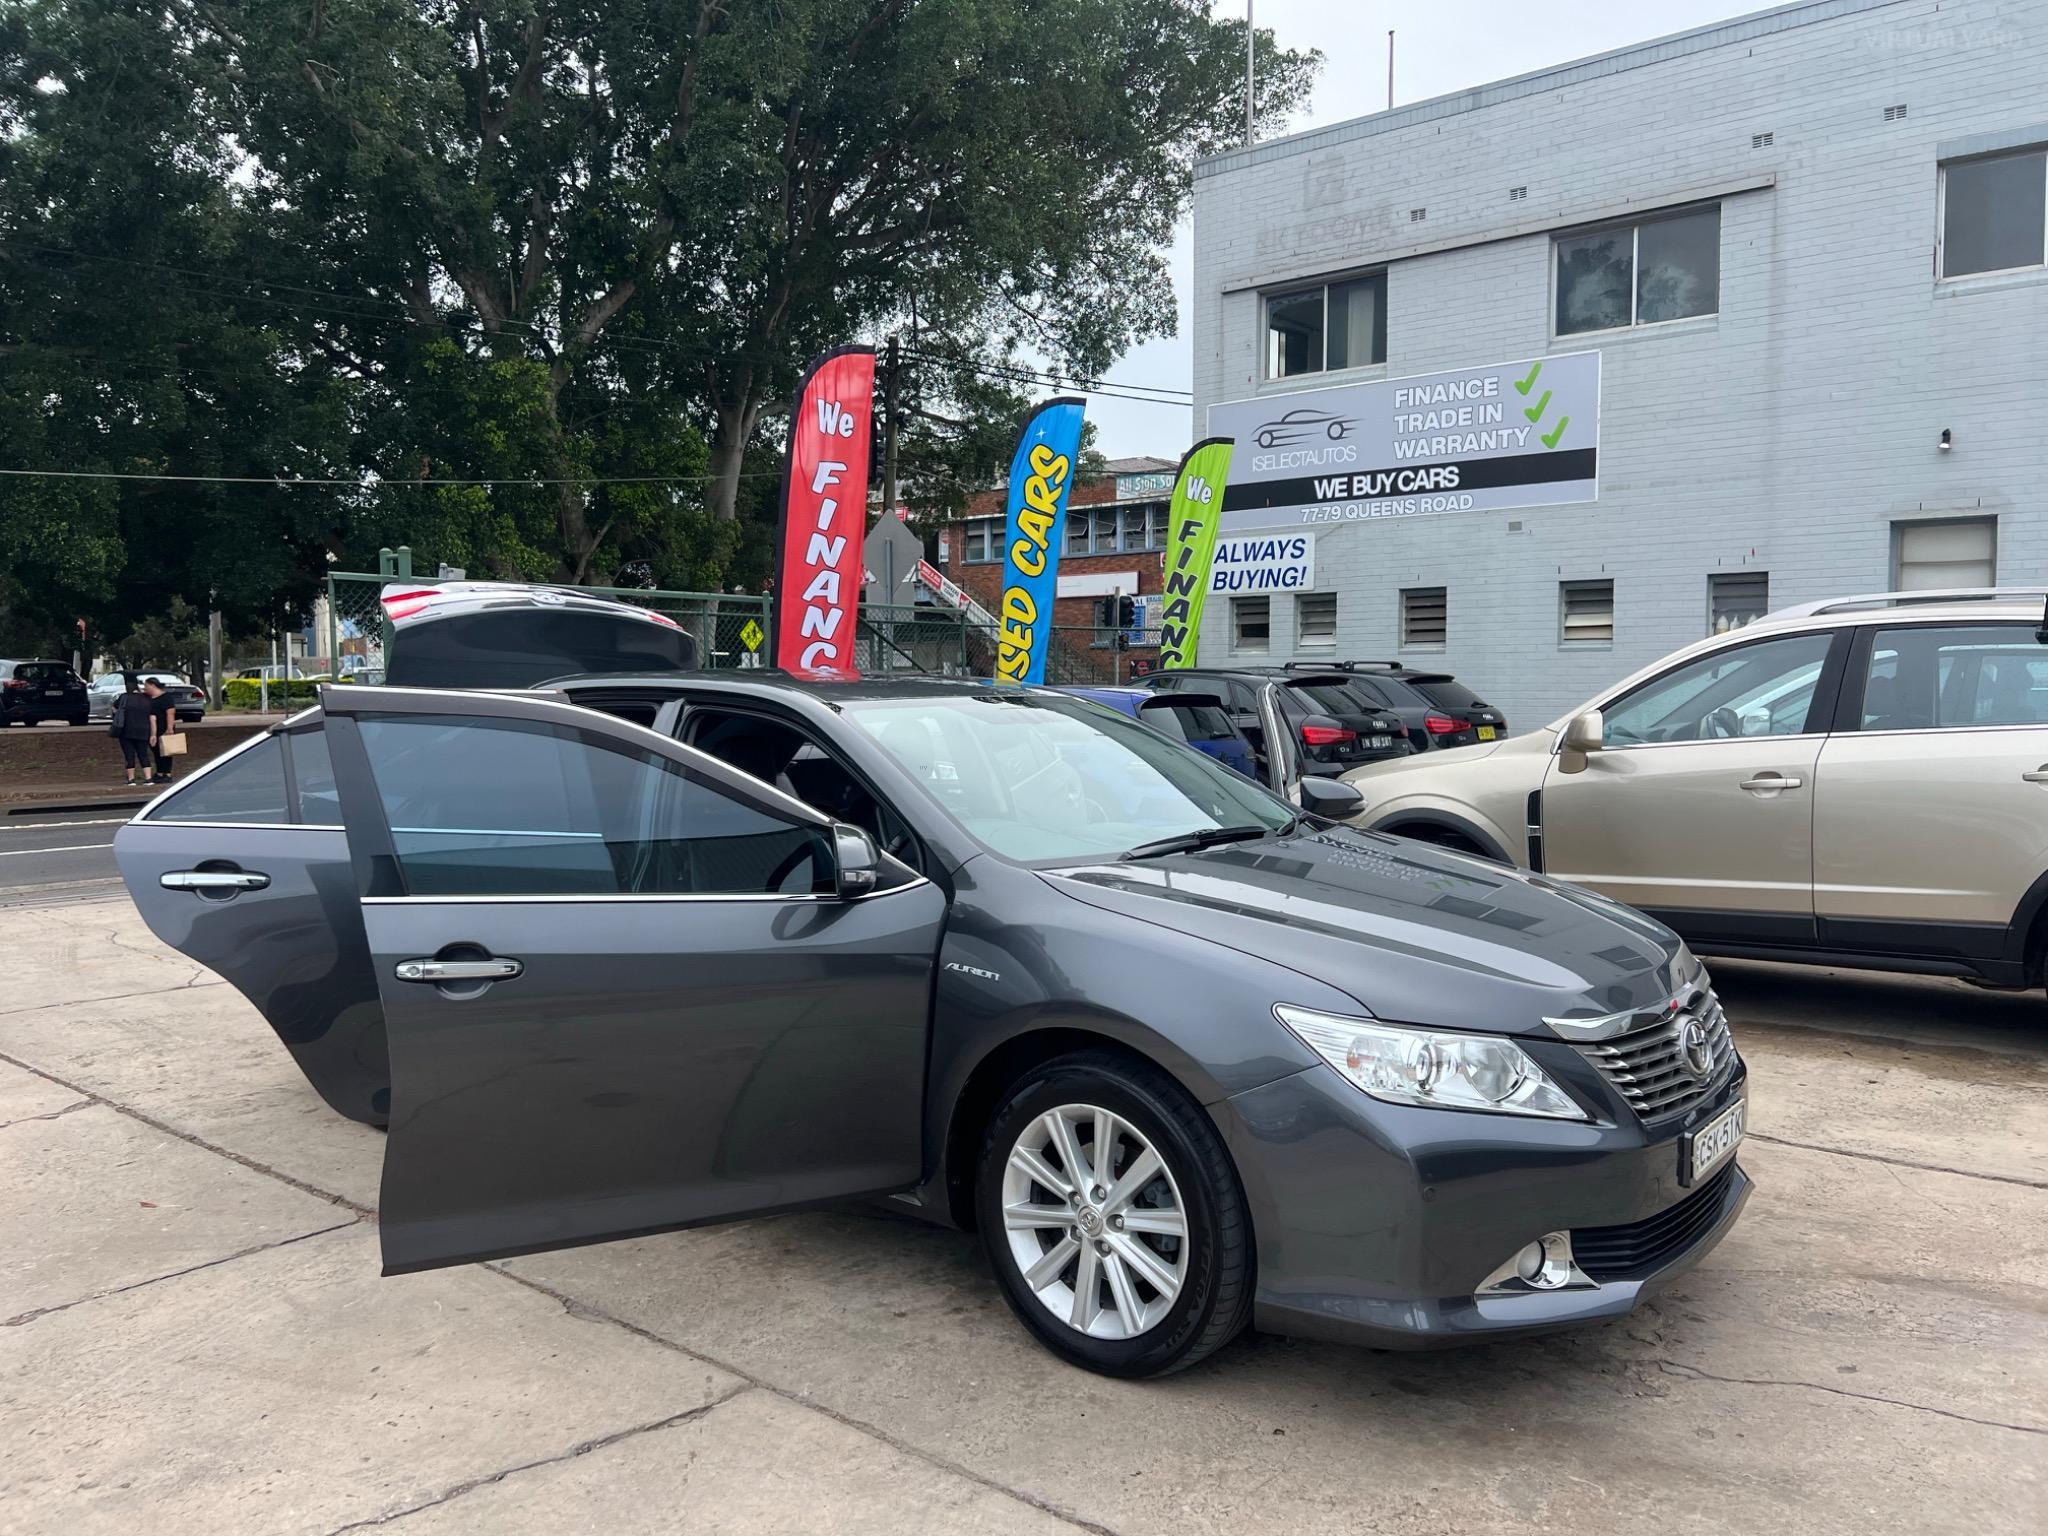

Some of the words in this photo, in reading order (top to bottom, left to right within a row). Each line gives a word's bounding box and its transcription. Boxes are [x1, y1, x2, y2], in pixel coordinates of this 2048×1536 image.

[1394, 376, 1499, 409] FINANCE
[816, 398, 857, 438] We
[1394, 405, 1474, 434] TRADE
[1477, 402, 1504, 426] IN
[1252, 445, 1358, 472] ISELECTAUTOS
[1393, 425, 1532, 460] WARRANTY
[1186, 475, 1212, 504] We
[1313, 477, 1349, 501] WE
[1352, 471, 1398, 497] BUY
[1397, 465, 1461, 493] CARS
[1011, 444, 1070, 577] CARS
[1301, 504, 1342, 524] 77-79
[1344, 498, 1417, 520] QUEENS
[1420, 494, 1474, 513] ROAD
[1213, 537, 1306, 564] ALWAYS
[1212, 566, 1307, 592] BUYING!
[998, 586, 1038, 686] SED
